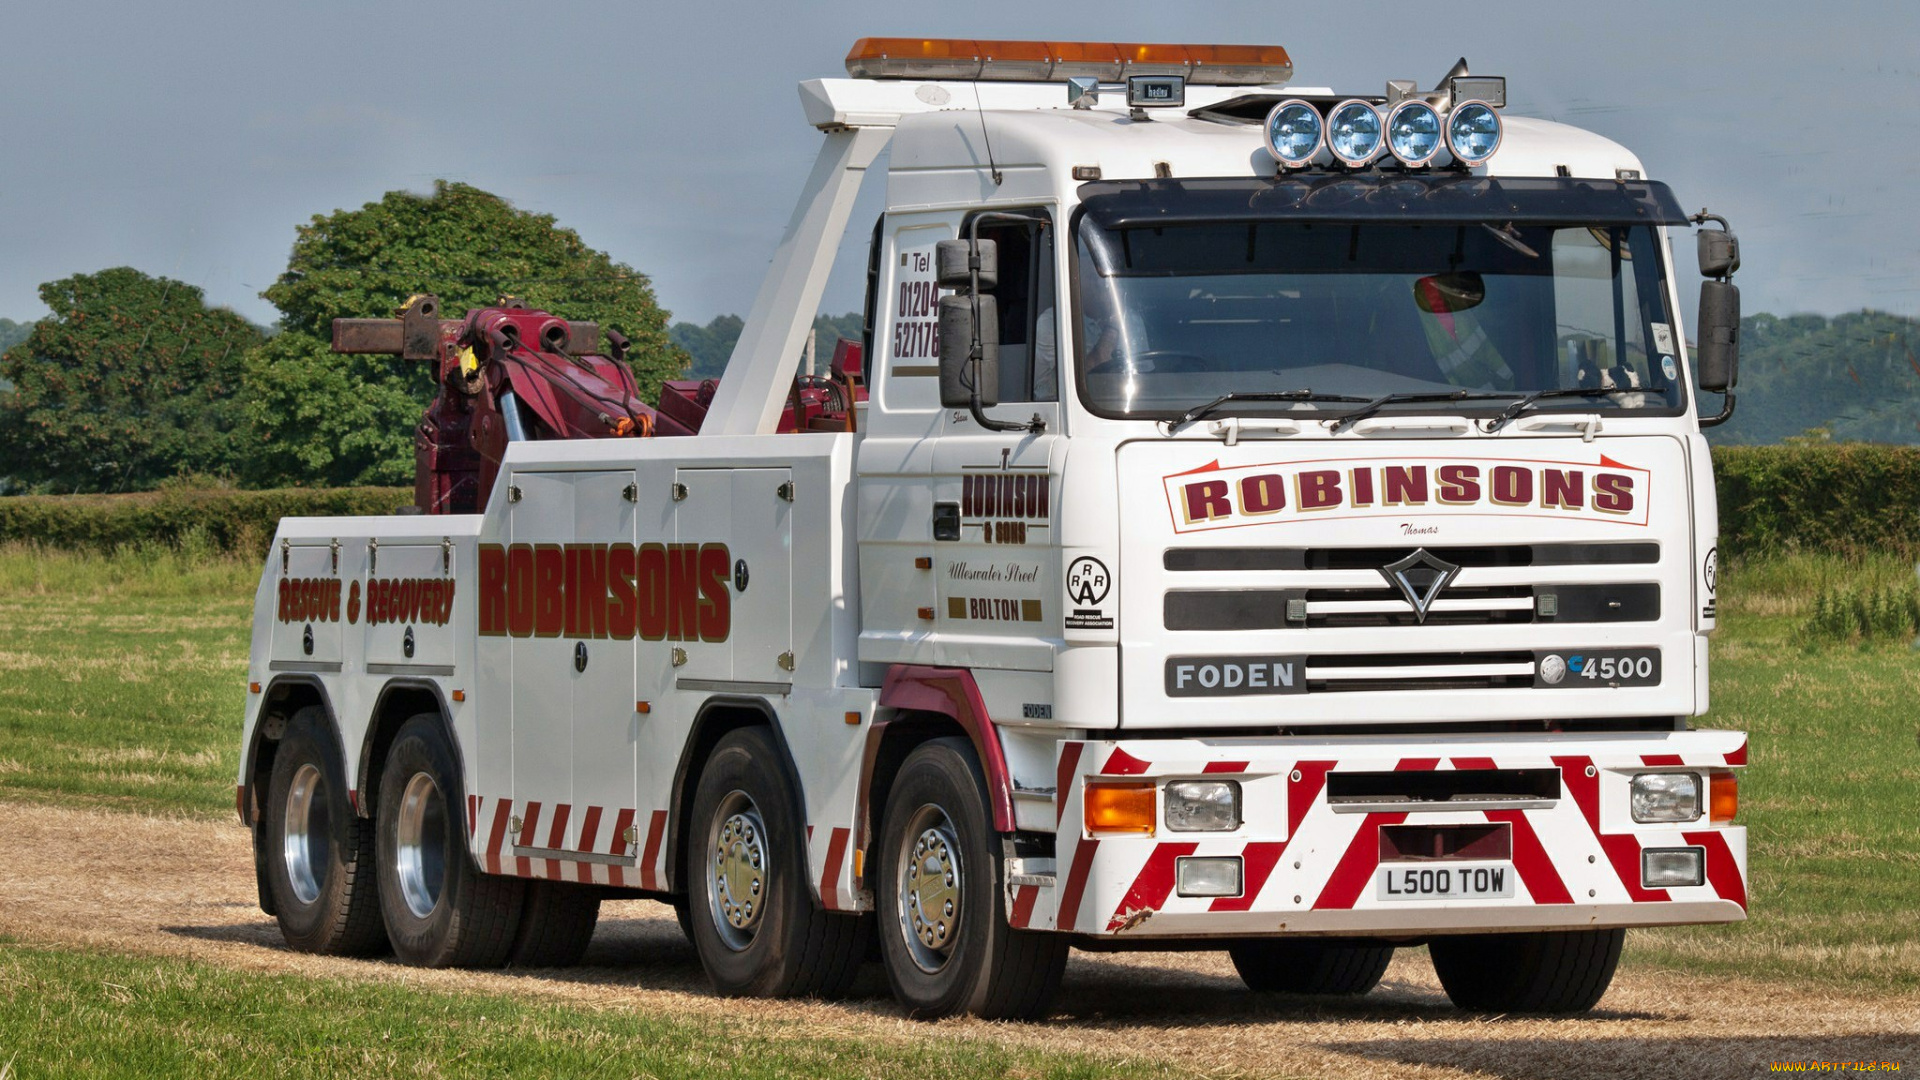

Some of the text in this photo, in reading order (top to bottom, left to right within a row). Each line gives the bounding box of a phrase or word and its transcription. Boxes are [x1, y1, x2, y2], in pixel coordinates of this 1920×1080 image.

[913, 252, 930, 272] Tel
[899, 281, 940, 317] 01204
[894, 322, 940, 357] 527176
[1002, 448, 1011, 471] T
[962, 474, 1049, 518] ROBINSON
[1175, 464, 1634, 524] ROBINSONS
[995, 521, 1026, 544] SONS
[1400, 523, 1439, 535] Thomas
[1004, 562, 1039, 582] Street
[278, 578, 455, 627] RESCUE & RECOVERY
[478, 543, 731, 643] ROBINSONS
[970, 598, 1020, 621] BOLTON
[1177, 663, 1293, 689] FODEN
[1581, 657, 1652, 679] 4500
[1023, 704, 1052, 719] FODEN
[1387, 868, 1504, 895] L500 TOW
